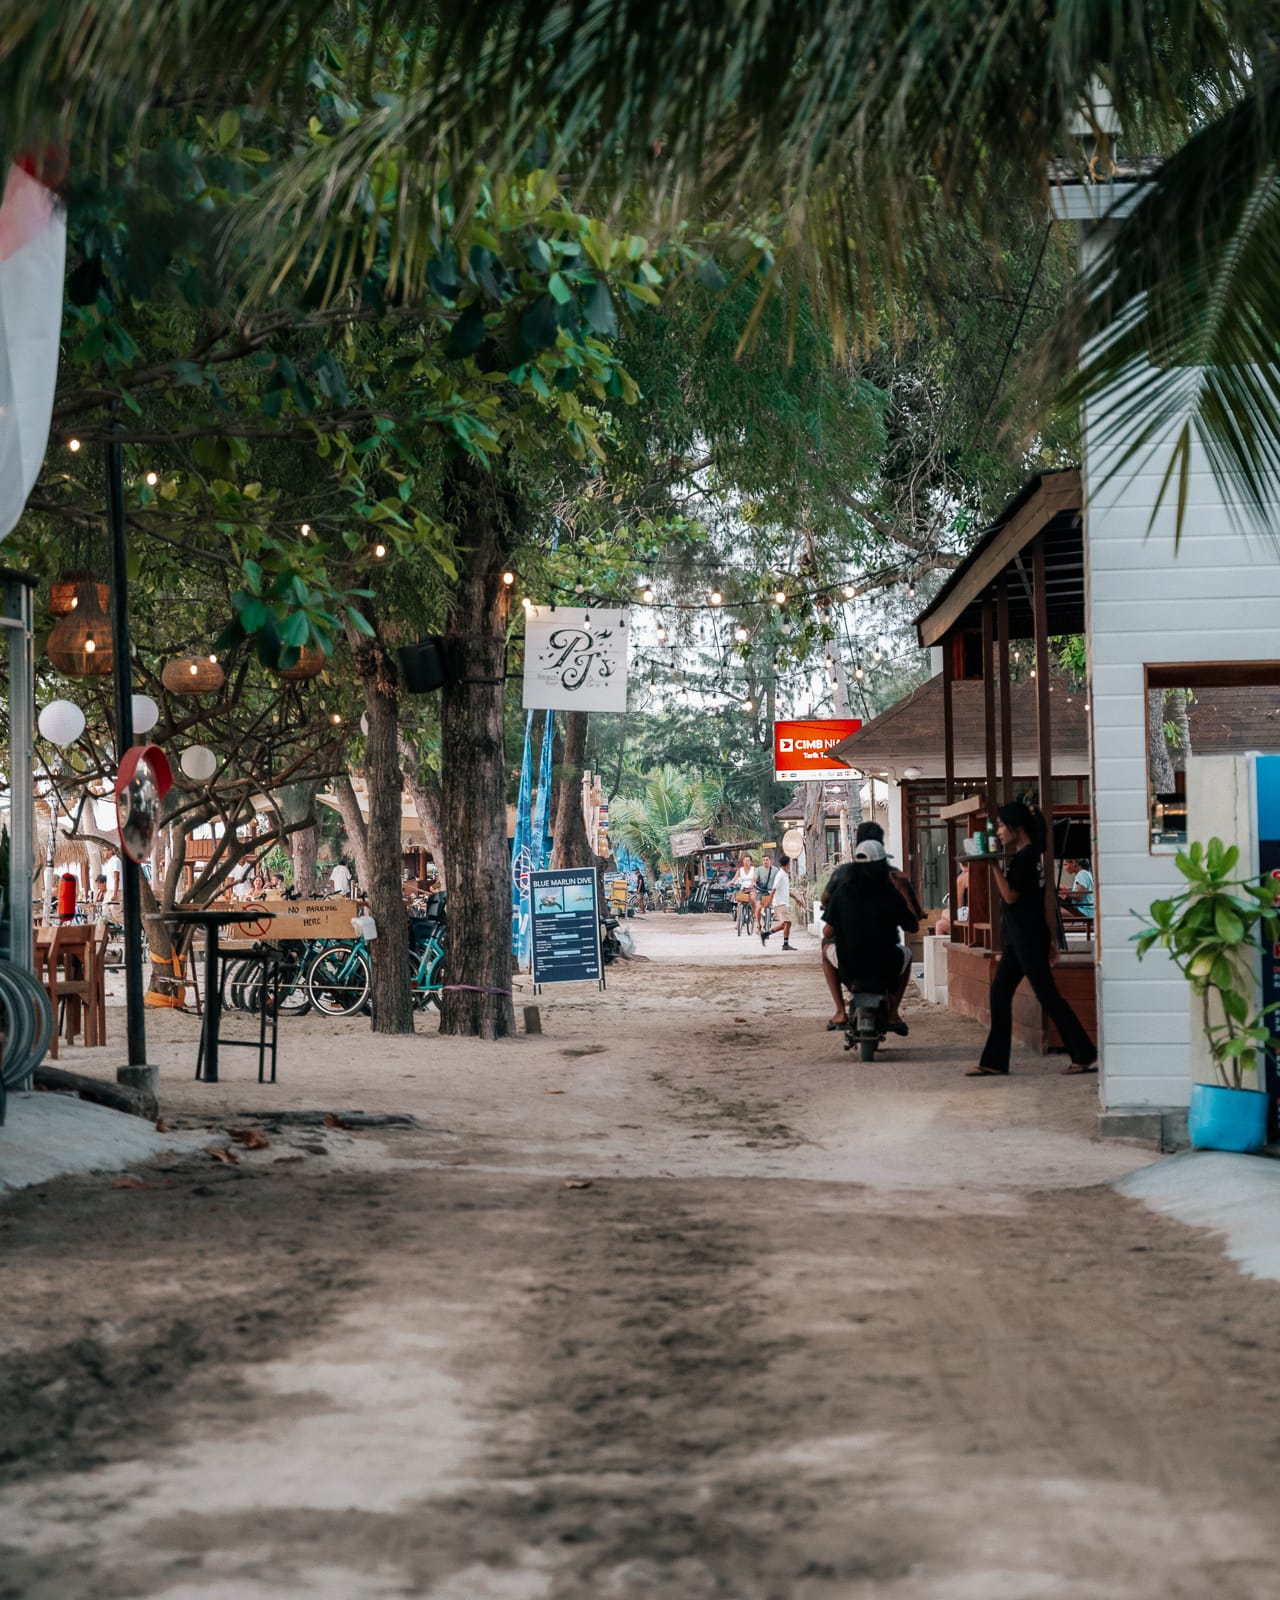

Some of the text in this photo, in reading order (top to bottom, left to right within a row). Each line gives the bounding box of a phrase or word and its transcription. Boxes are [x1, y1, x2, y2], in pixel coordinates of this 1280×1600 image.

[795, 739, 823, 749] CIMB
[551, 878, 576, 886] MARLIN
[577, 876, 593, 884] DIVE
[306, 905, 337, 913] PARKING
[303, 918, 320, 926] HERE
